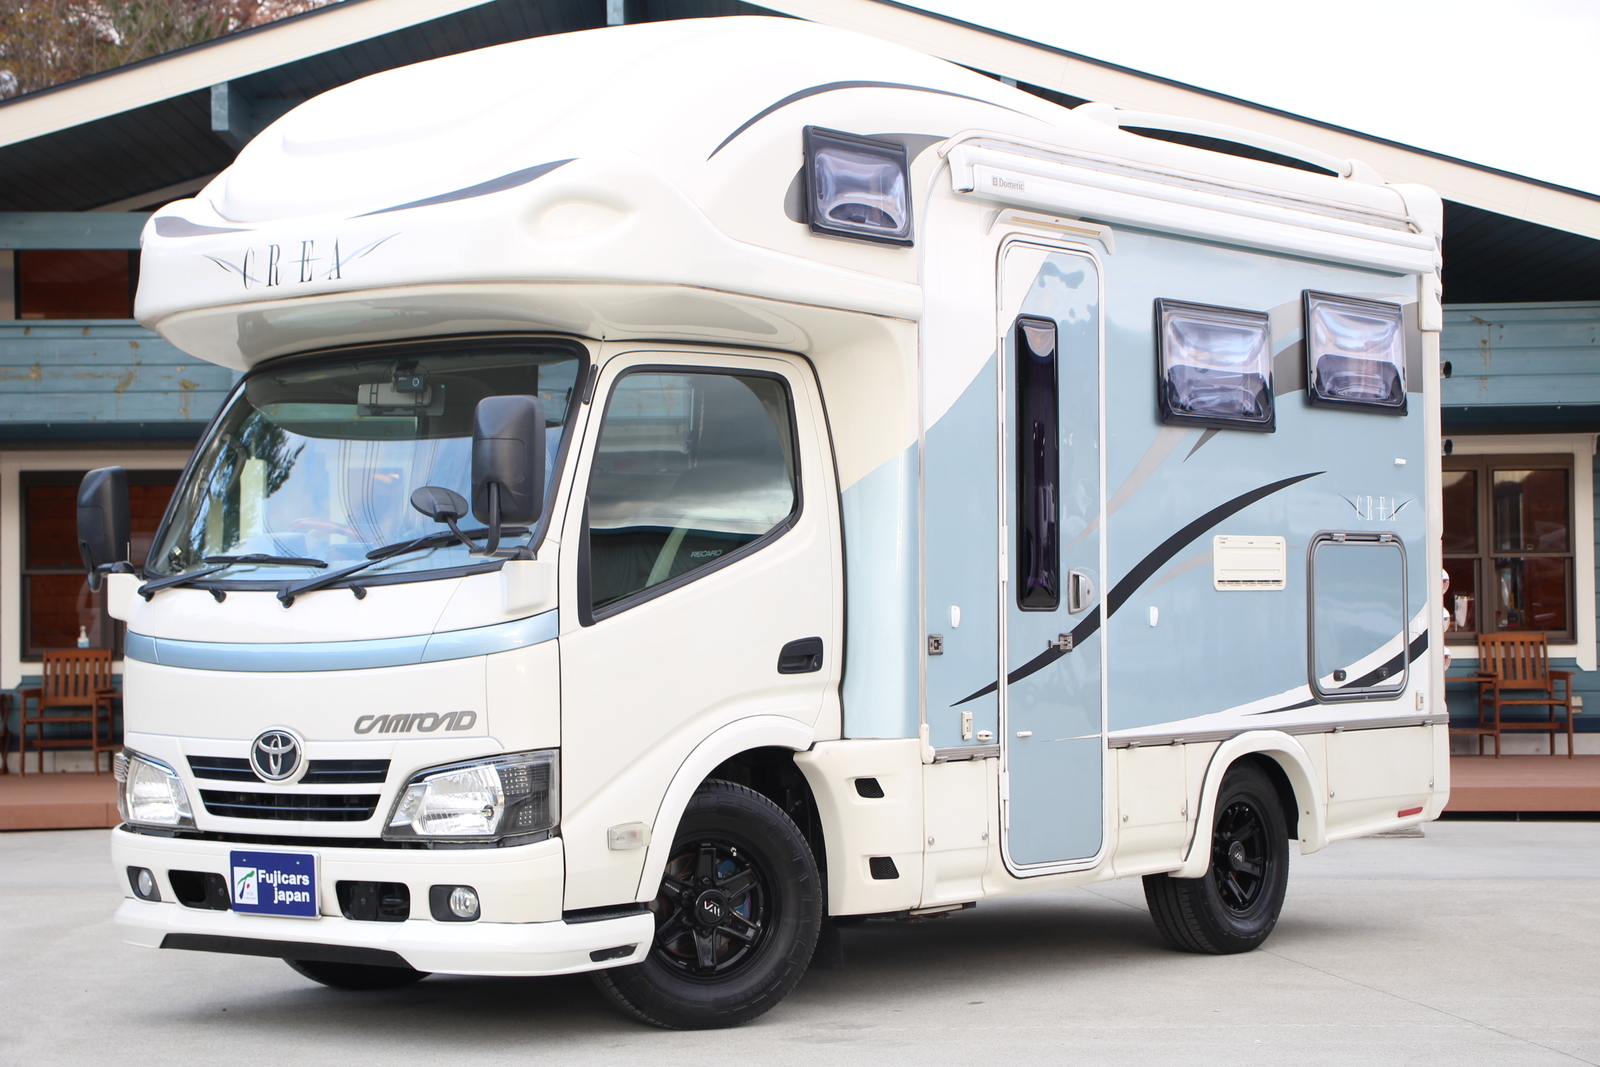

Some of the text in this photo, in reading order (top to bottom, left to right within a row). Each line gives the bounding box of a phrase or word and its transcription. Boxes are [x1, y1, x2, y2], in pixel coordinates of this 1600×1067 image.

[998, 178, 1025, 190] Dometic
[243, 236, 343, 290] CREA
[1356, 494, 1397, 522] CREA
[690, 549, 723, 558] RECARO
[353, 710, 477, 734] CAMROAD
[257, 869, 310, 887] Fujicars
[273, 887, 310, 905] japan
